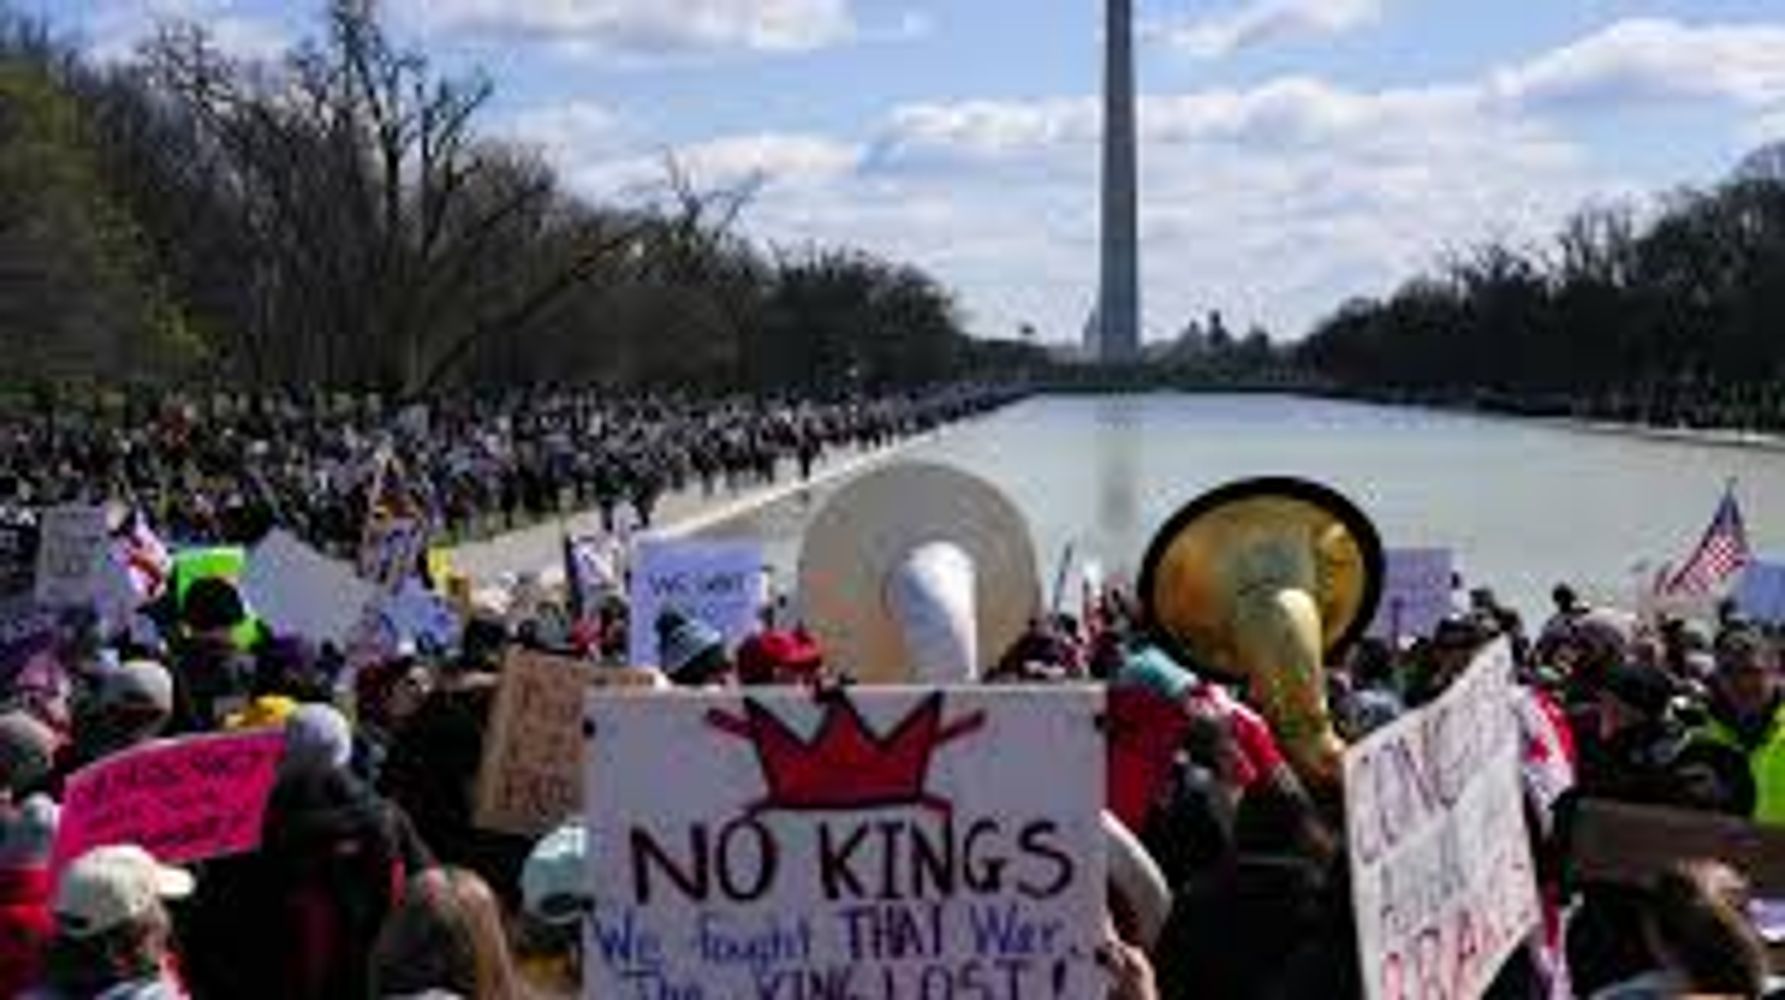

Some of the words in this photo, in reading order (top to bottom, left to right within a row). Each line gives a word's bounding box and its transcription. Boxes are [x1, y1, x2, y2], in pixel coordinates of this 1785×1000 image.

[629, 817, 779, 903] NO
[818, 817, 1075, 901] KINGS
[592, 902, 661, 963] We
[840, 906, 944, 960] THAT
